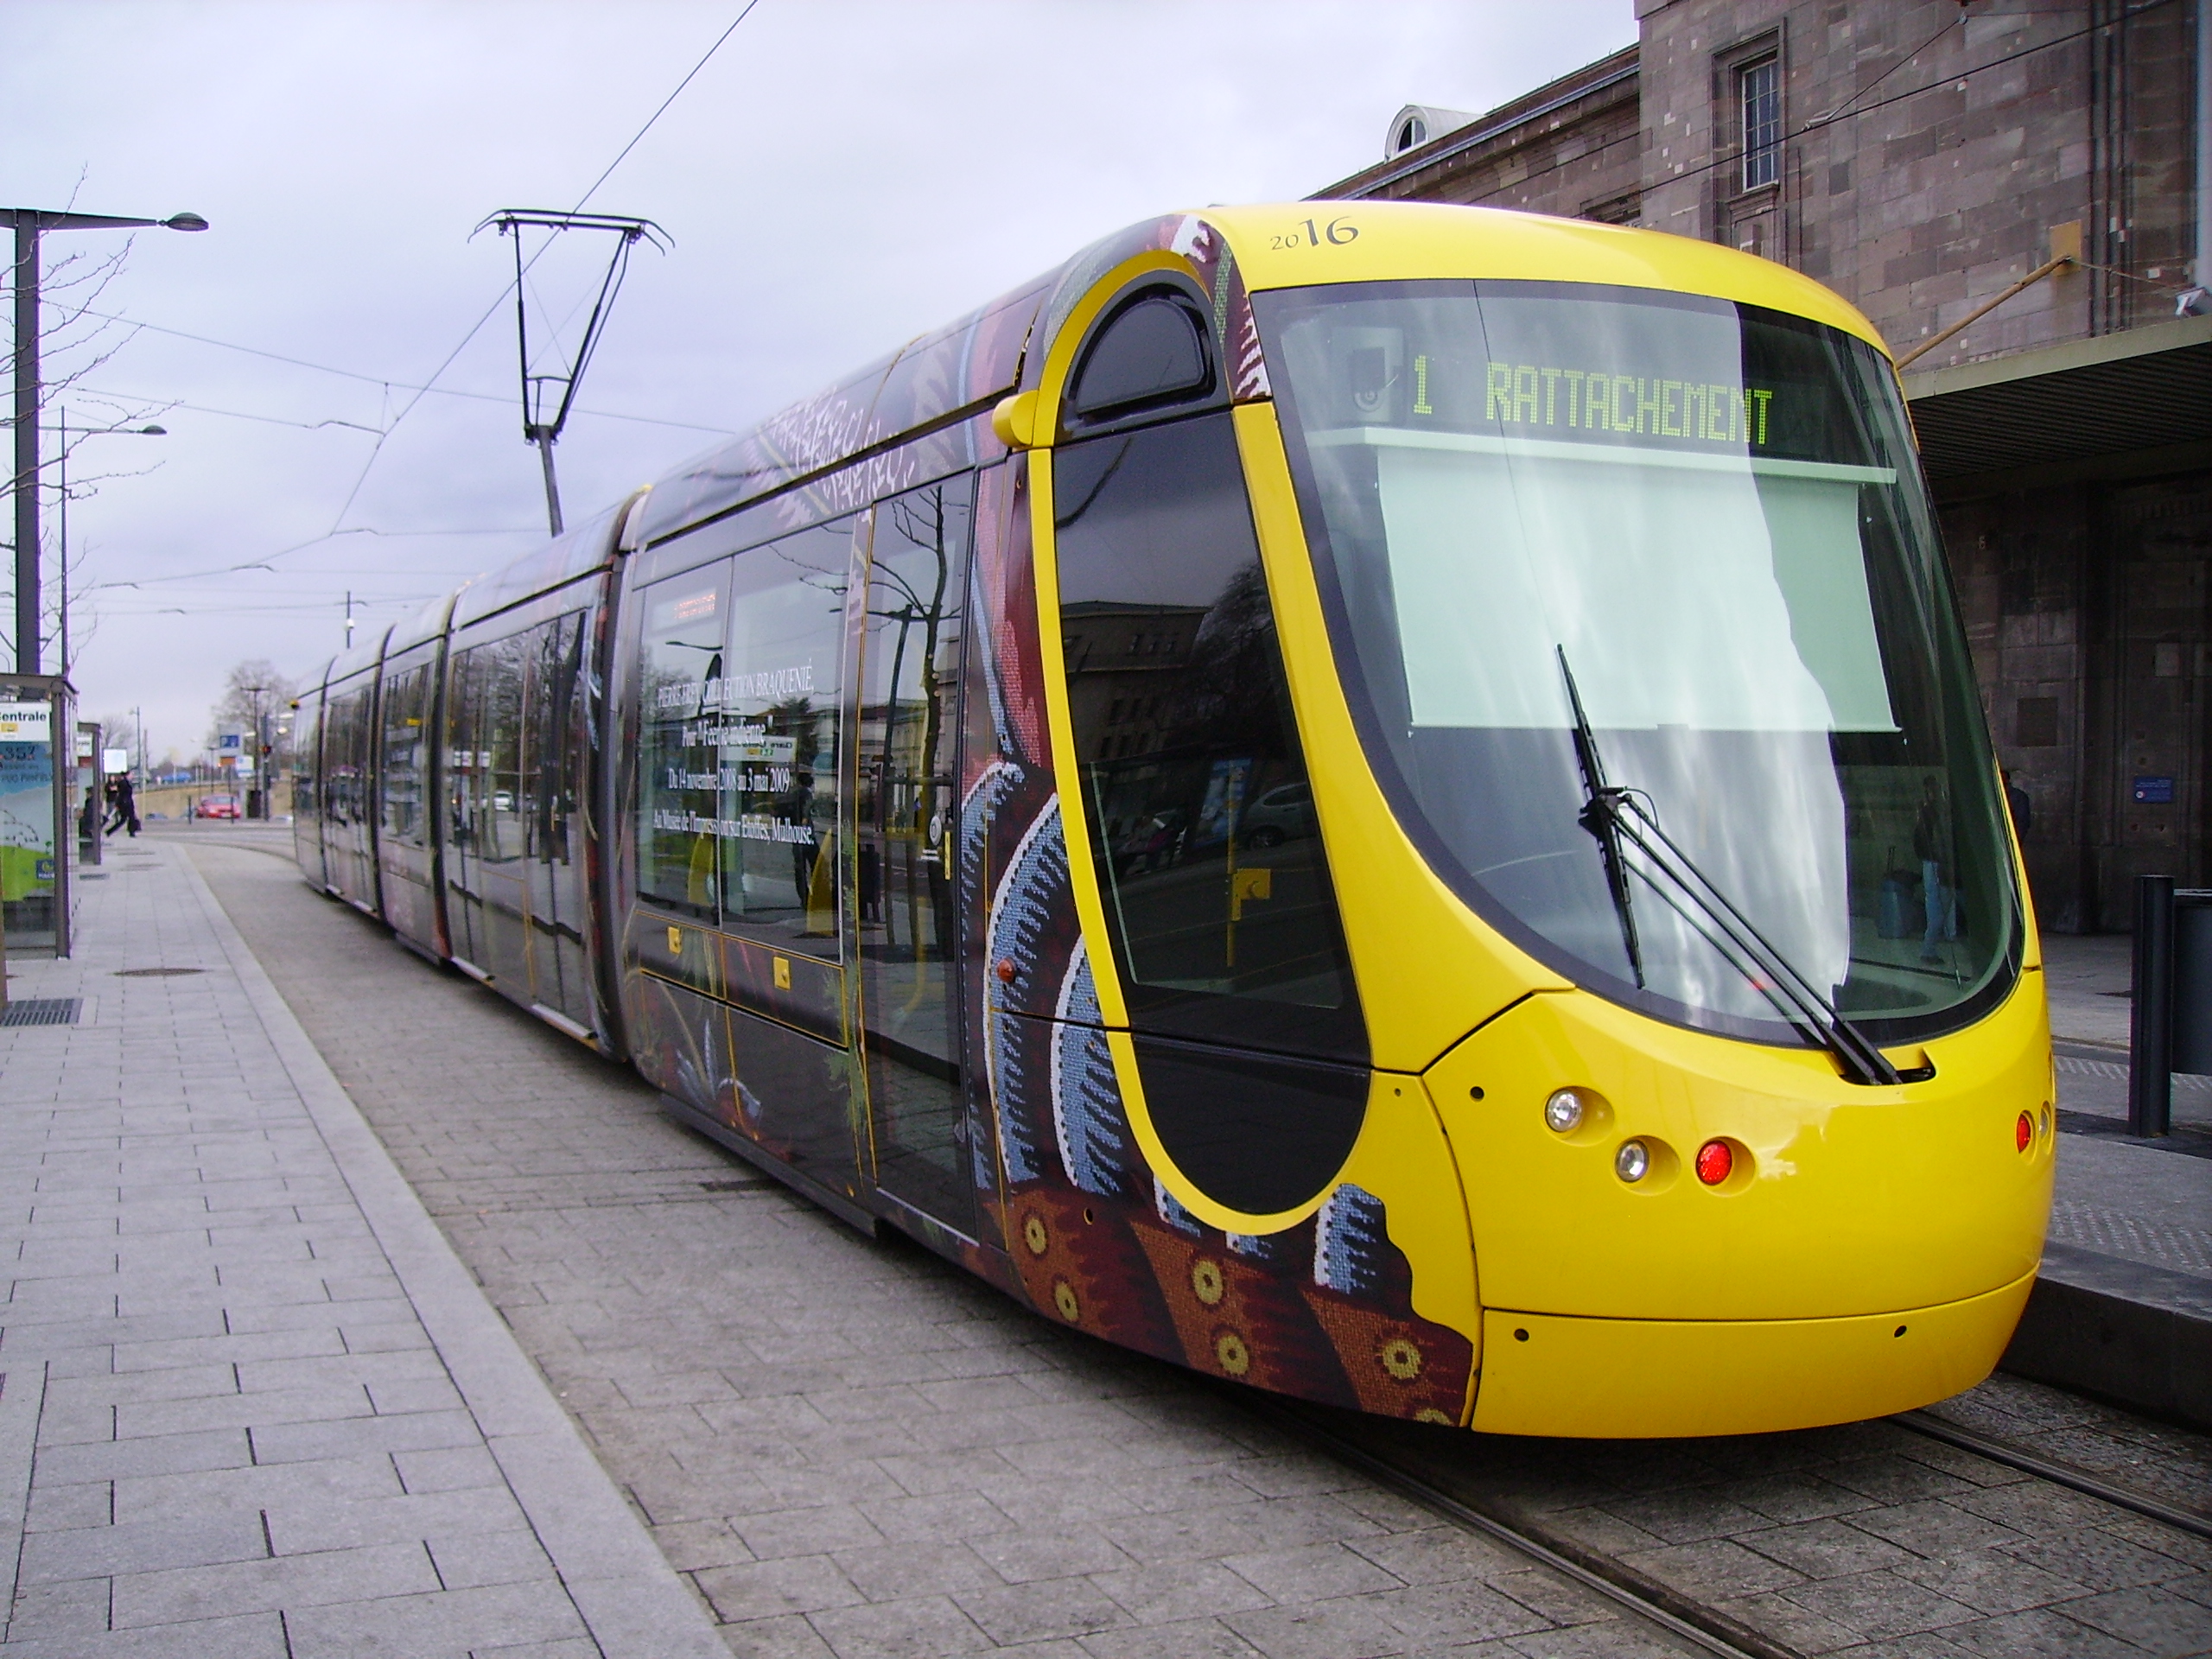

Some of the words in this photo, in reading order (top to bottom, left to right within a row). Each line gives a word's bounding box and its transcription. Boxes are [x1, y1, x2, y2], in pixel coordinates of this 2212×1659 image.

[1269, 215, 1359, 251] 2016
[1413, 355, 1433, 415] 1
[1485, 361, 1773, 446] RATTACHEMENT
[747, 766, 753, 792] 3
[753, 766, 768, 792] mai
[770, 767, 790, 792] 2009
[772, 817, 815, 844] Mulhouse.
